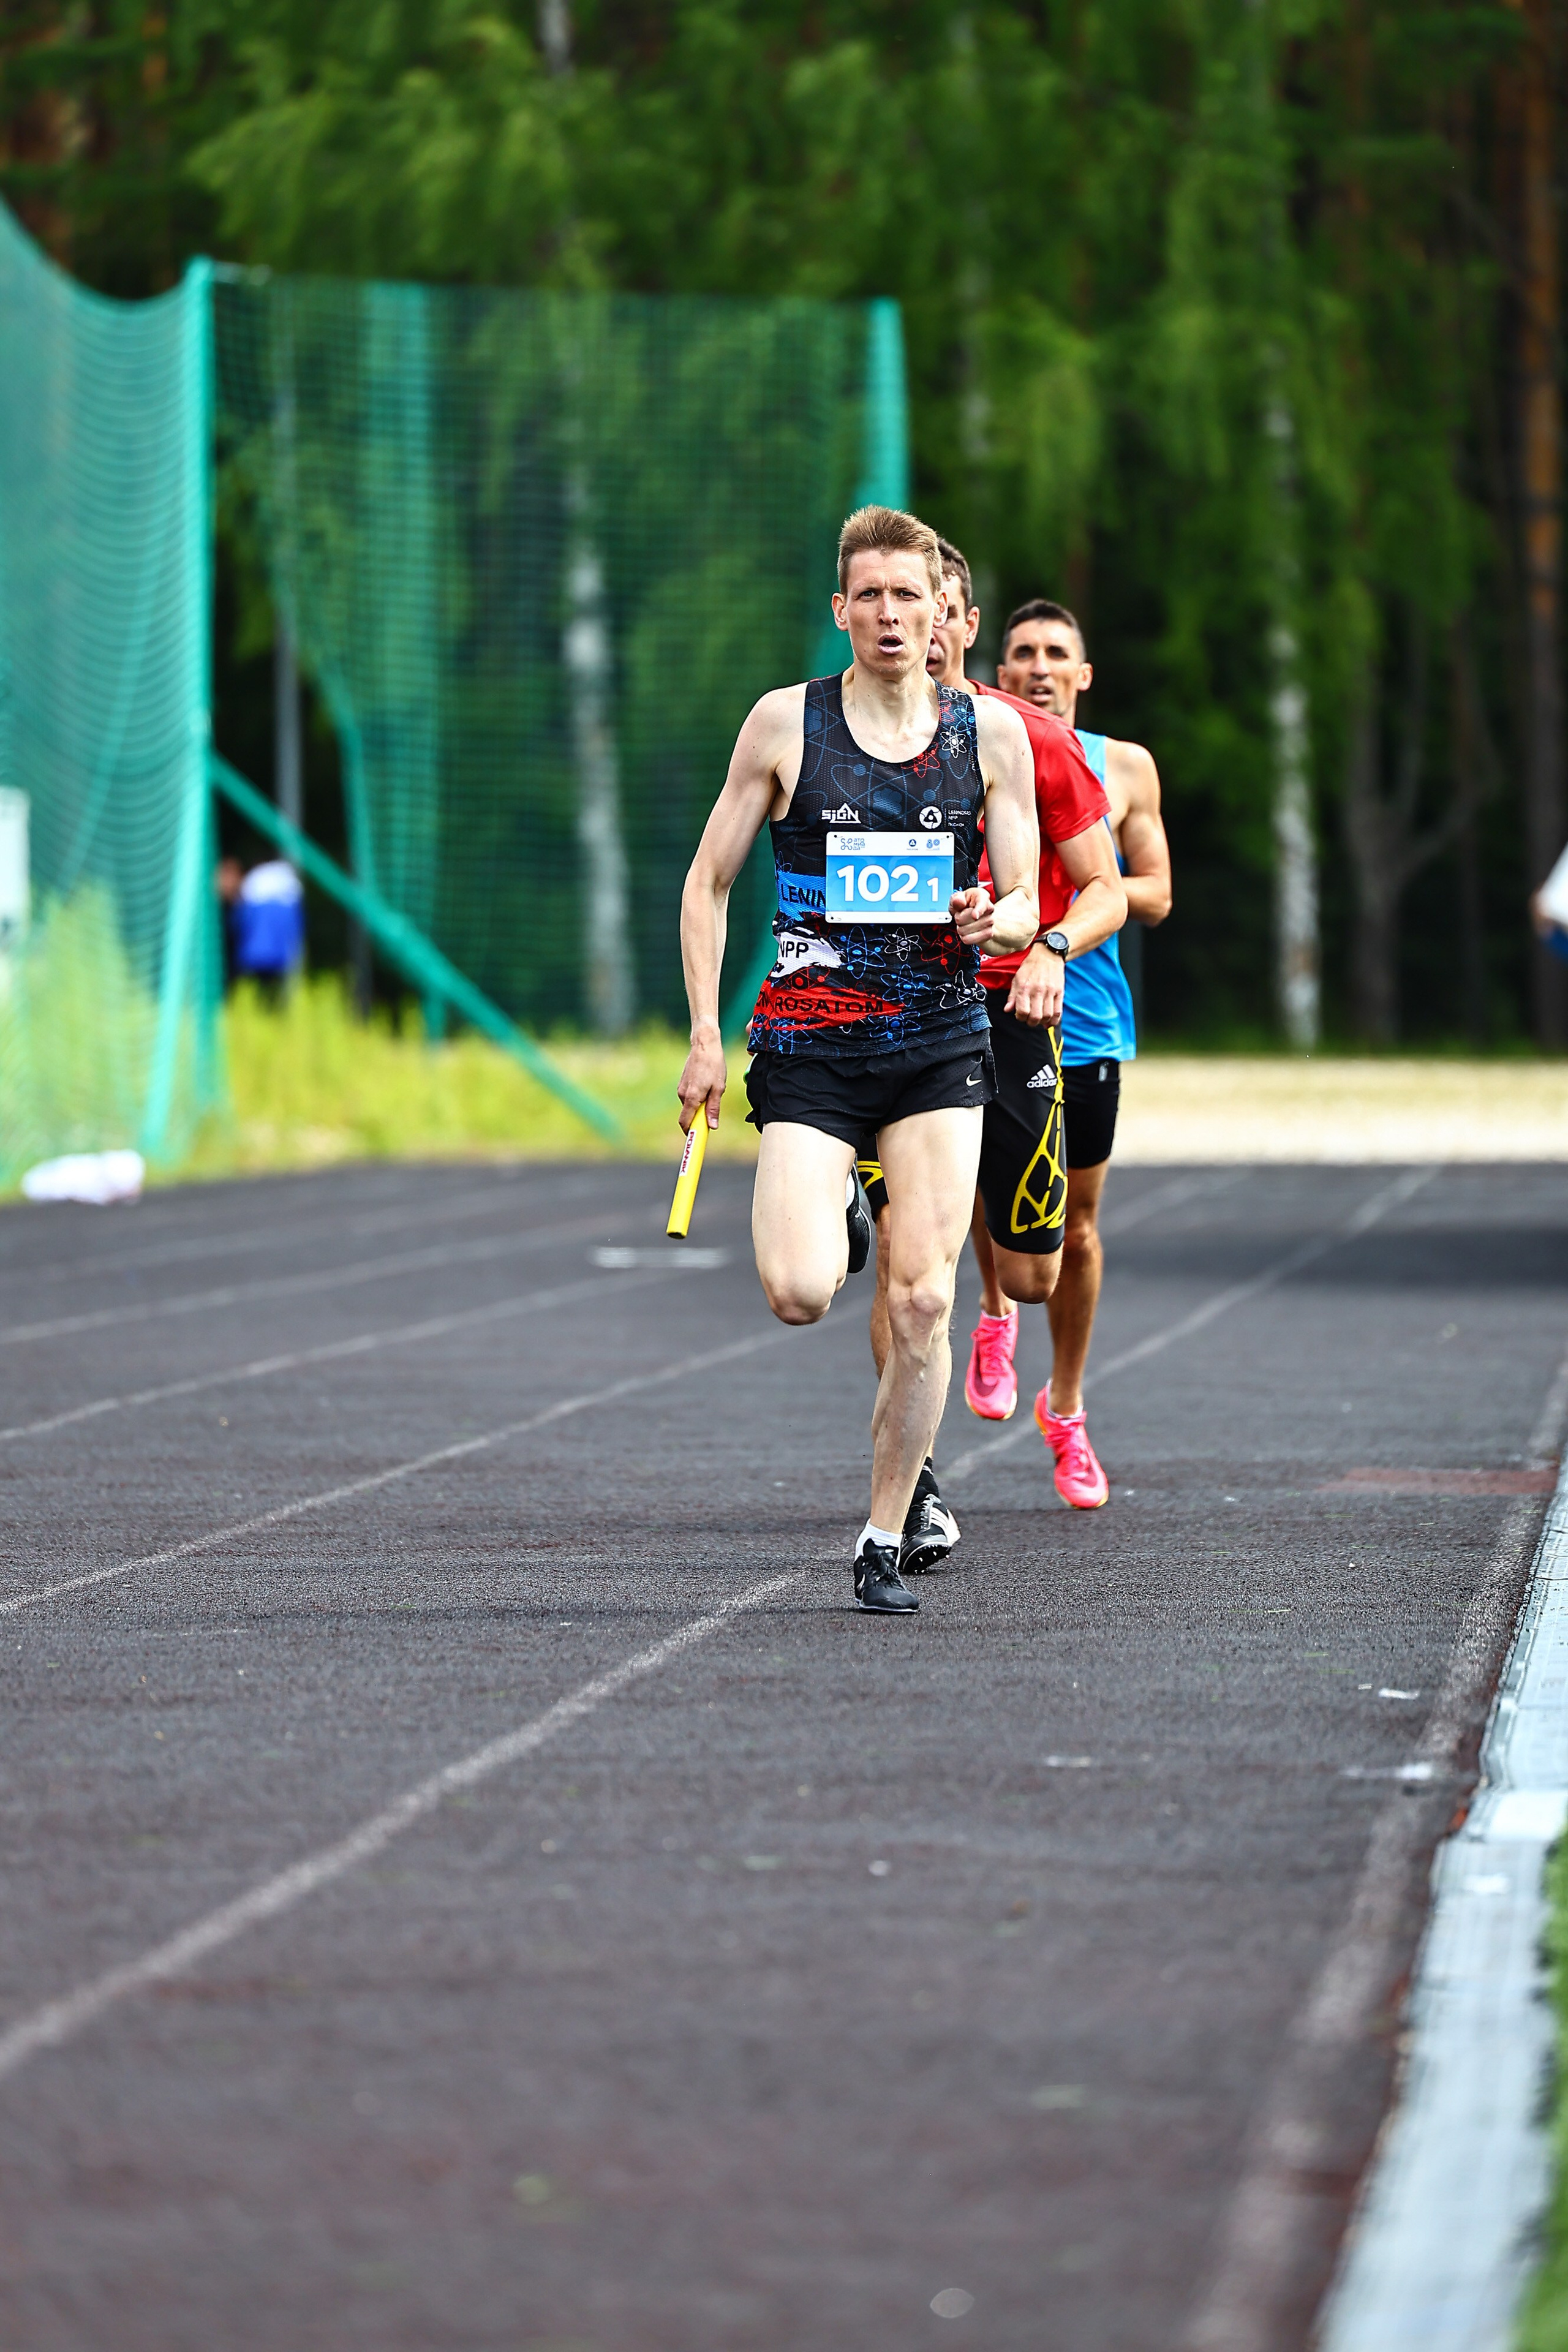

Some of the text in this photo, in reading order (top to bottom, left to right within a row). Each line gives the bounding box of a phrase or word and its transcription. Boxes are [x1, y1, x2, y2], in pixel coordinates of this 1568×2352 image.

[837, 865, 938, 902] 102 1
[779, 940, 809, 959] NPP
[775, 996, 883, 1013] ROSATOM
